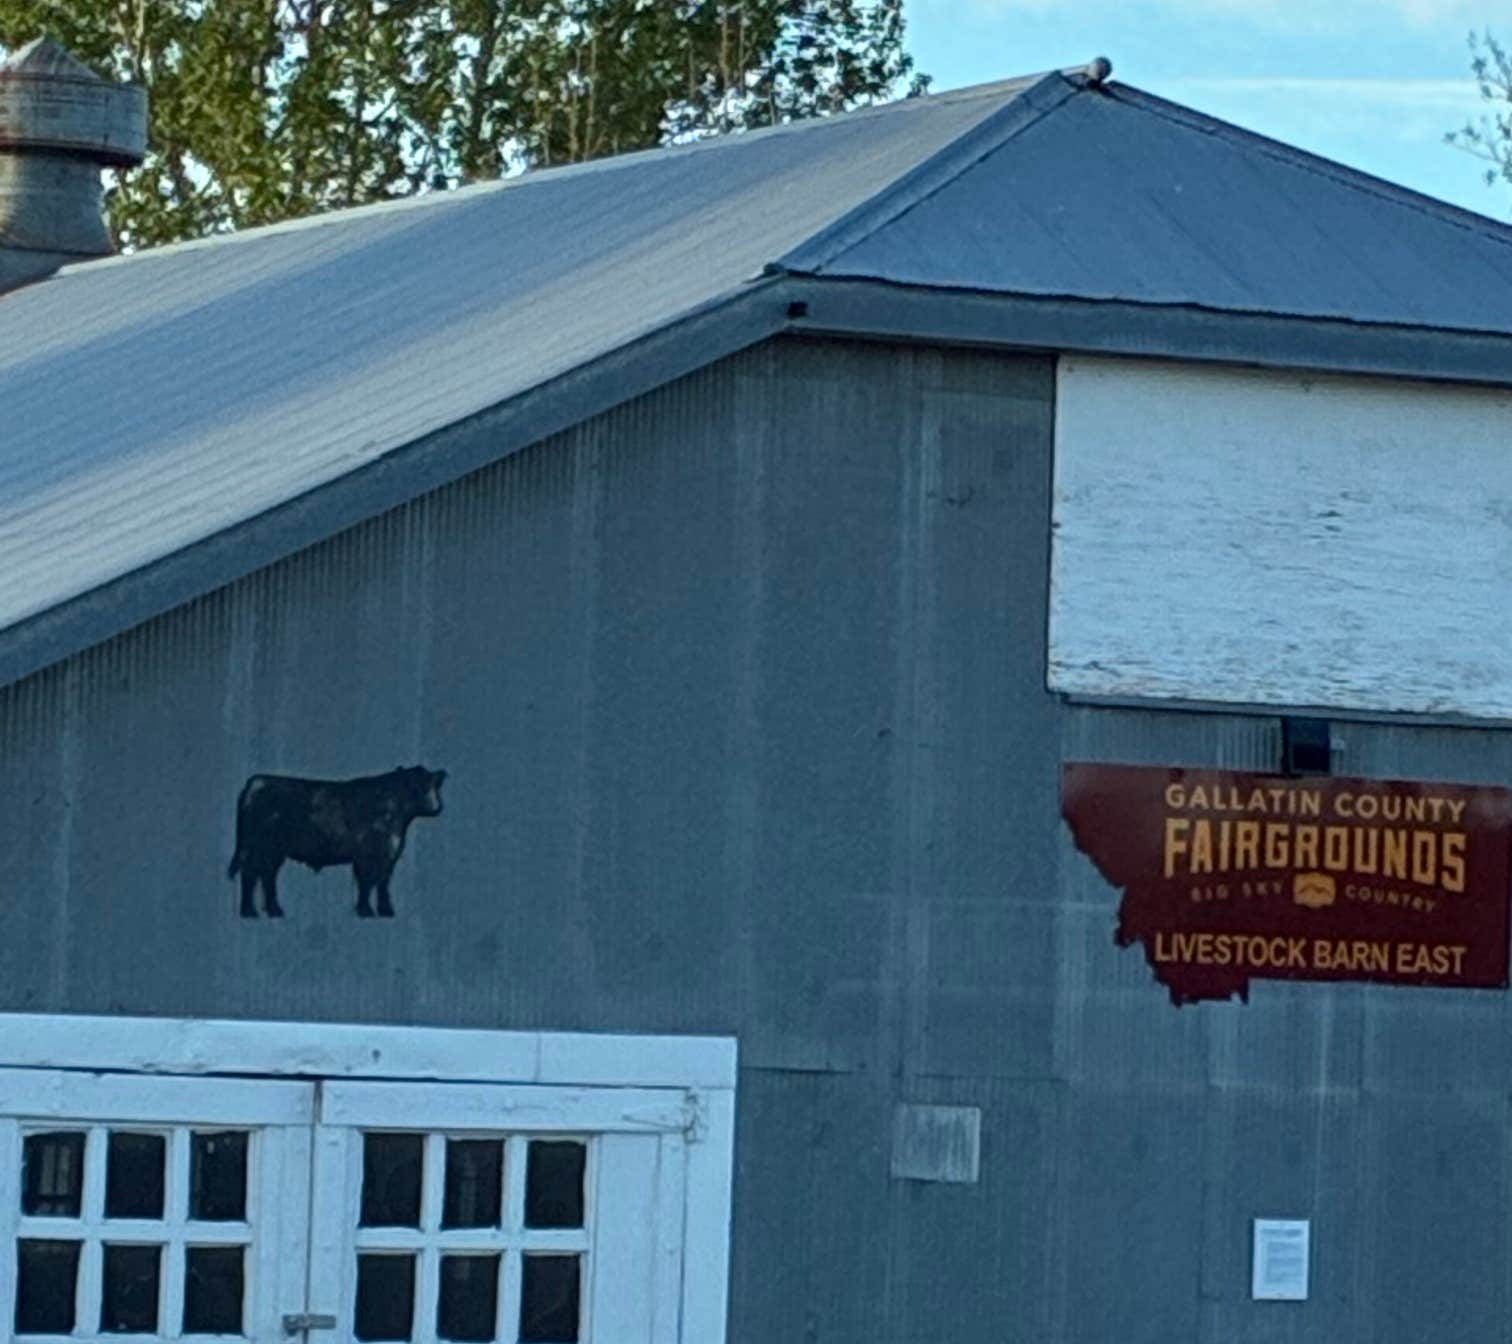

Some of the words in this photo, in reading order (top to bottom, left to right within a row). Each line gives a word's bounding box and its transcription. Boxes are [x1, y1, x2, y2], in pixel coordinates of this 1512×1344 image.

[1165, 783, 1321, 816] GALLATIN
[1334, 792, 1466, 823] COUNTY
[1164, 817, 1467, 894] FAIRGROUNDS
[1345, 884, 1437, 913] COUNTRY
[1154, 932, 1307, 968] LIVESTOCK
[1313, 940, 1390, 973] BARN
[1396, 943, 1467, 975] EAST
